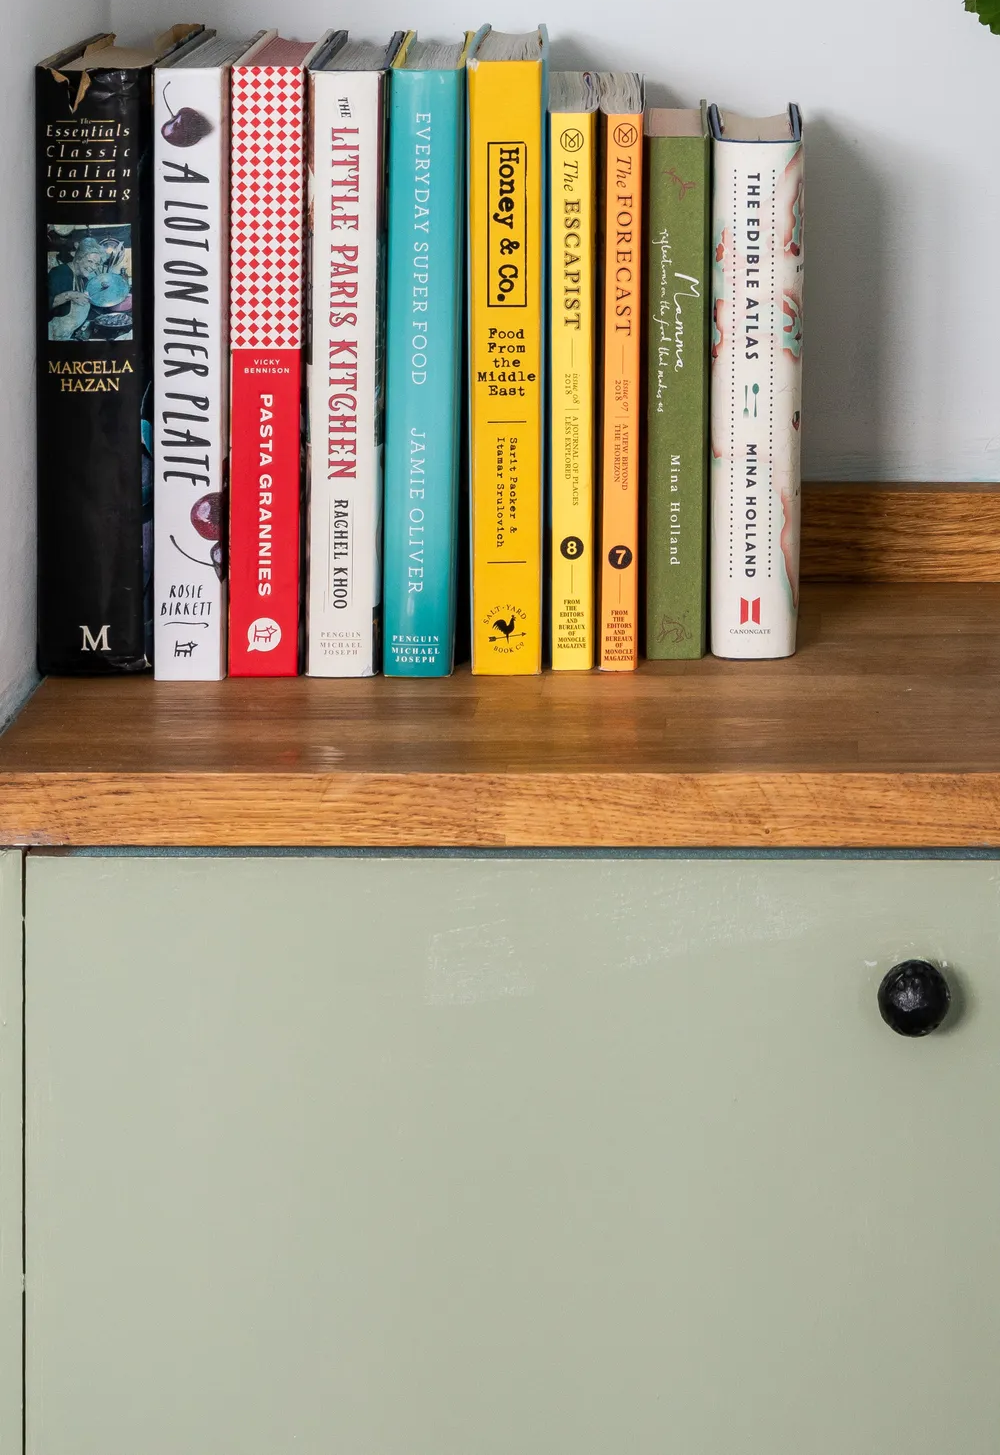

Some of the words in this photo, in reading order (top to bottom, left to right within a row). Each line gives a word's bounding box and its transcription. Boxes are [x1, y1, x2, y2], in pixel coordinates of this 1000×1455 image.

[338, 97, 351, 118] THE
[46, 124, 130, 137] Essentials
[46, 145, 131, 158] Classic
[47, 165, 131, 178] Italian
[162, 160, 210, 183] A
[330, 127, 359, 231] LITTLE
[414, 112, 431, 233] EVERYDAY
[492, 147, 519, 229] Honey
[563, 160, 578, 192] The
[616, 156, 632, 188] The
[47, 185, 131, 201] Cooking
[746, 173, 760, 209] THE
[163, 200, 210, 251] LOT
[500, 238, 520, 255] &
[746, 218, 760, 288] EDIBLE
[163, 260, 209, 304] ON
[412, 242, 429, 313] SUPER
[564, 199, 581, 330] ESCAPIST
[615, 195, 632, 336] FORECAST
[329, 244, 359, 328] PARIS
[496, 264, 519, 302] Co.
[660, 300, 670, 315] the
[674, 272, 700, 372] Mamma
[488, 328, 524, 339] Food
[745, 298, 759, 360] ATLAS
[163, 317, 209, 378] HER
[411, 321, 428, 385] FOOD
[488, 343, 526, 353] From
[492, 358, 520, 368] the
[658, 346, 669, 366] that
[48, 360, 133, 374] MARCELLA
[477, 371, 536, 382] Middle
[572, 373, 580, 391] issue
[61, 378, 119, 392] HAZAN
[489, 385, 525, 396] East
[564, 374, 572, 396] 2018
[573, 393, 580, 404] 08
[623, 379, 631, 398] issue
[327, 339, 358, 480] KITCHEN
[622, 401, 628, 412] 07
[161, 392, 211, 487] PLATE
[259, 394, 273, 466] PASTA
[571, 422, 579, 461] JOURNAL
[409, 428, 426, 499] JAMIE
[497, 437, 505, 479] Itamar
[509, 437, 518, 471] Sarit
[572, 464, 579, 474] OF
[745, 444, 757, 488] MINA
[670, 454, 681, 492] Mina
[509, 477, 518, 519] Packer
[333, 500, 348, 559] RACHEL
[496, 484, 505, 548] Srulovich
[509, 526, 517, 534] &
[258, 474, 273, 596] GRANNIES
[408, 508, 424, 594] OLIVER
[567, 541, 577, 555] 8
[670, 502, 681, 566] Holland
[745, 497, 757, 578] HOLLAND
[616, 550, 626, 565] 7
[169, 584, 203, 599] ROSIE
[332, 567, 348, 609] KHOO
[160, 601, 212, 616] BIRKETT
[79, 625, 111, 651] M
[392, 646, 440, 654] MICHAEL
